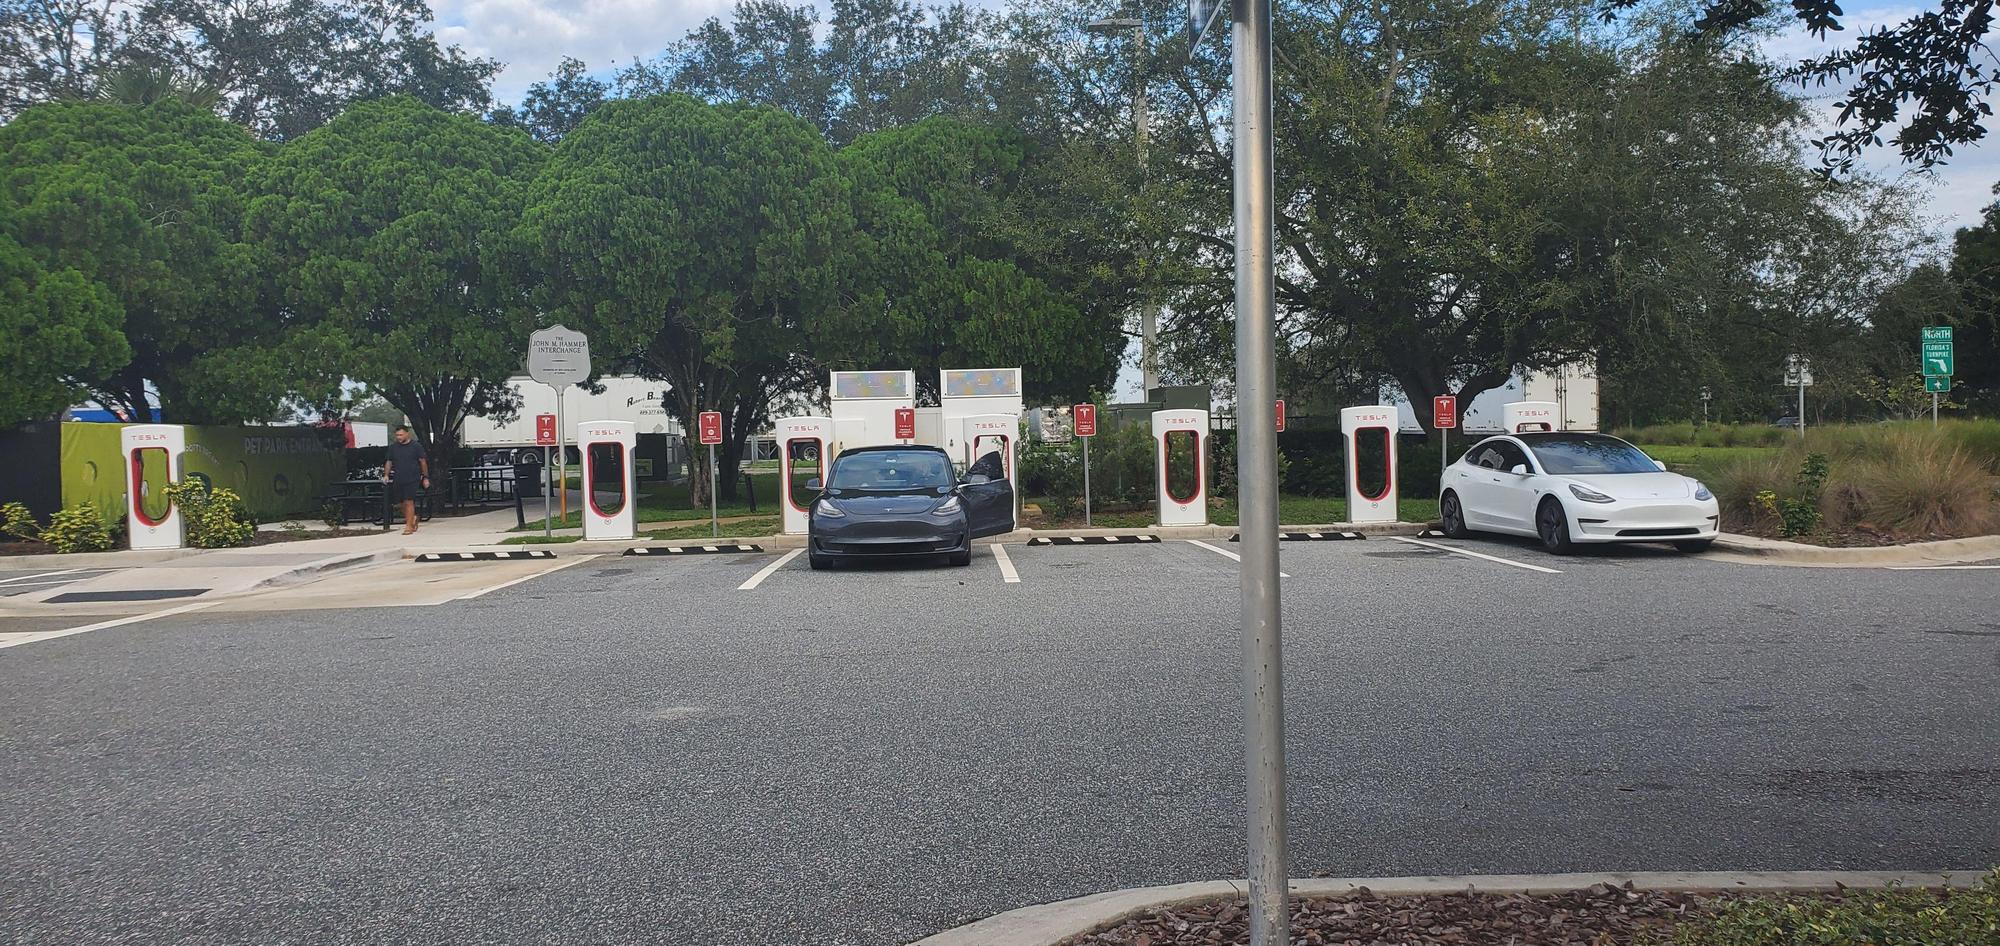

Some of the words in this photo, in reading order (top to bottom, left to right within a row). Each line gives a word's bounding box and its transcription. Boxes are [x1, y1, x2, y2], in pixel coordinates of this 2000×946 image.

[1924, 330, 1950, 339] NORTH
[244, 437, 261, 456] PET
[264, 438, 288, 455] PARK
